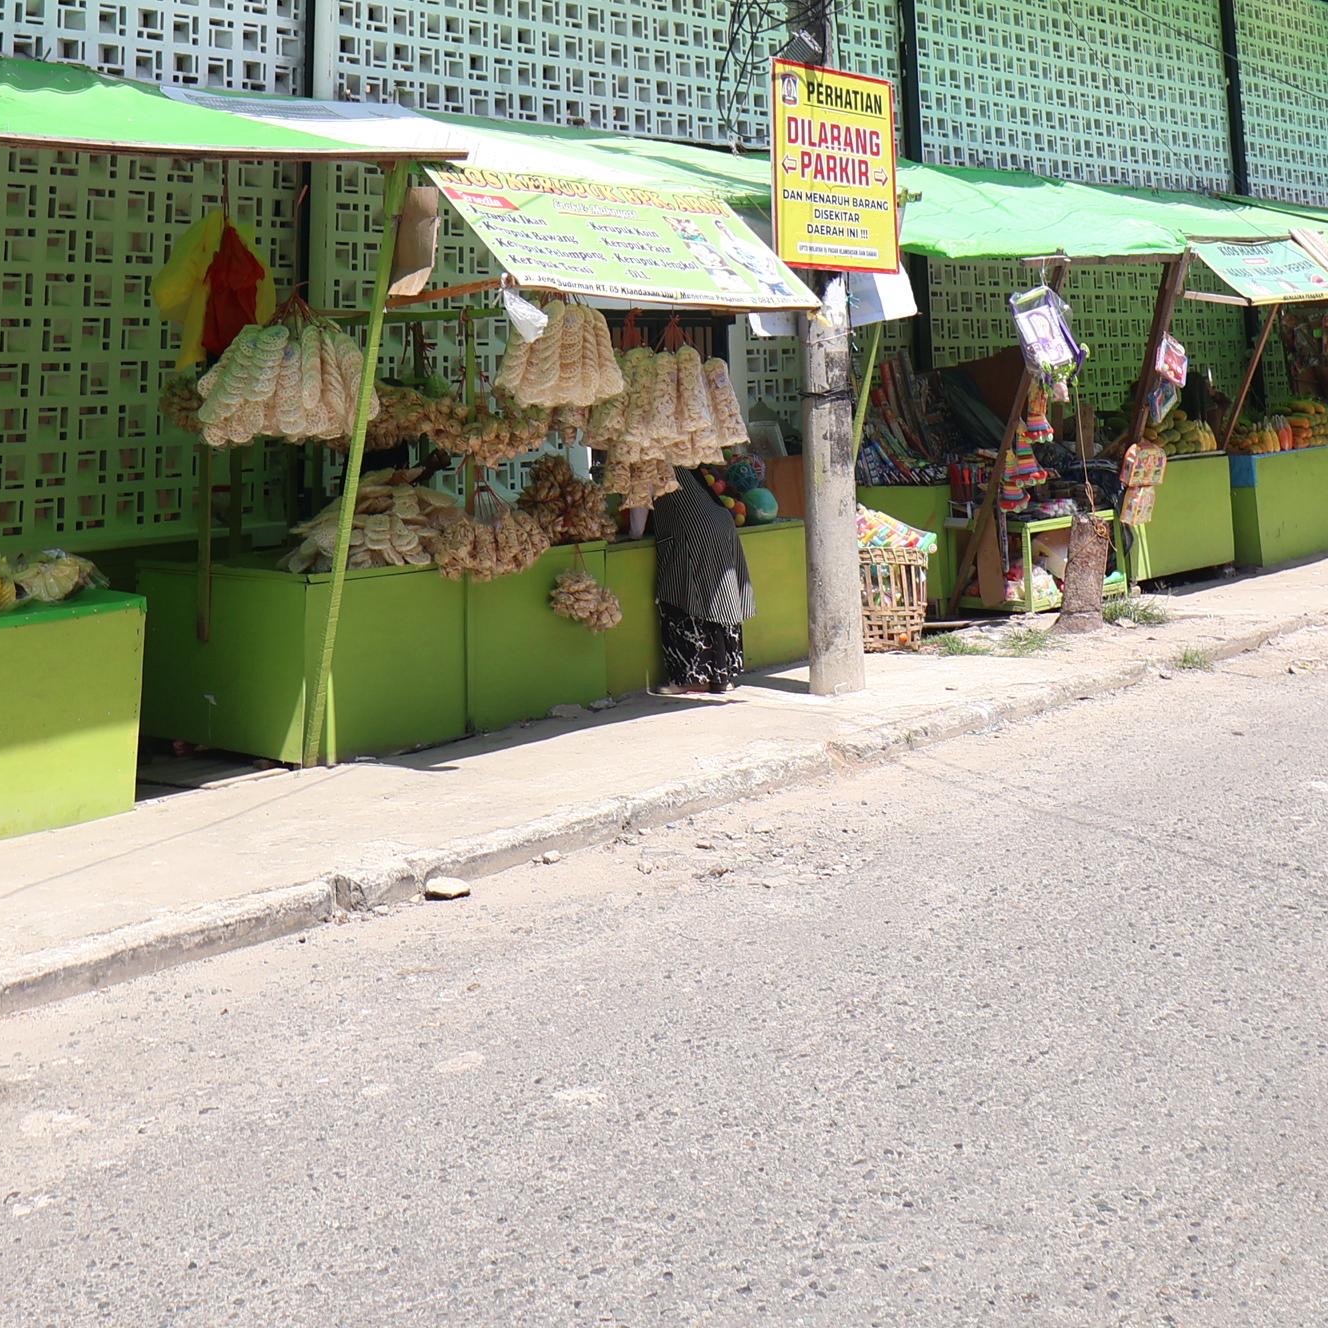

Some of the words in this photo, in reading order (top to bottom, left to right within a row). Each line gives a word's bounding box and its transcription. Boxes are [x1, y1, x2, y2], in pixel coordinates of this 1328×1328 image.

[807, 80, 882, 115] PERHATIAN
[787, 116, 880, 157] DILARANG
[801, 151, 870, 186] PARKIR
[505, 172, 623, 203] KERUPUK
[783, 189, 803, 201] DAN
[805, 191, 850, 207] MENARUH
[853, 197, 889, 211] BARANG
[519, 215, 548, 226] Ikan
[814, 208, 860, 223] DISEKITAR
[588, 221, 634, 235] Kerupuk
[807, 223, 844, 237] DAERAH
[847, 227, 859, 238] INI
[532, 231, 580, 245] Bawang
[601, 237, 647, 250] Kerupuk
[614, 252, 660, 267] Kerupuk
[660, 259, 700, 271] Jengkol
[556, 279, 594, 291] Sudirman
[621, 287, 661, 298] Klandasan
